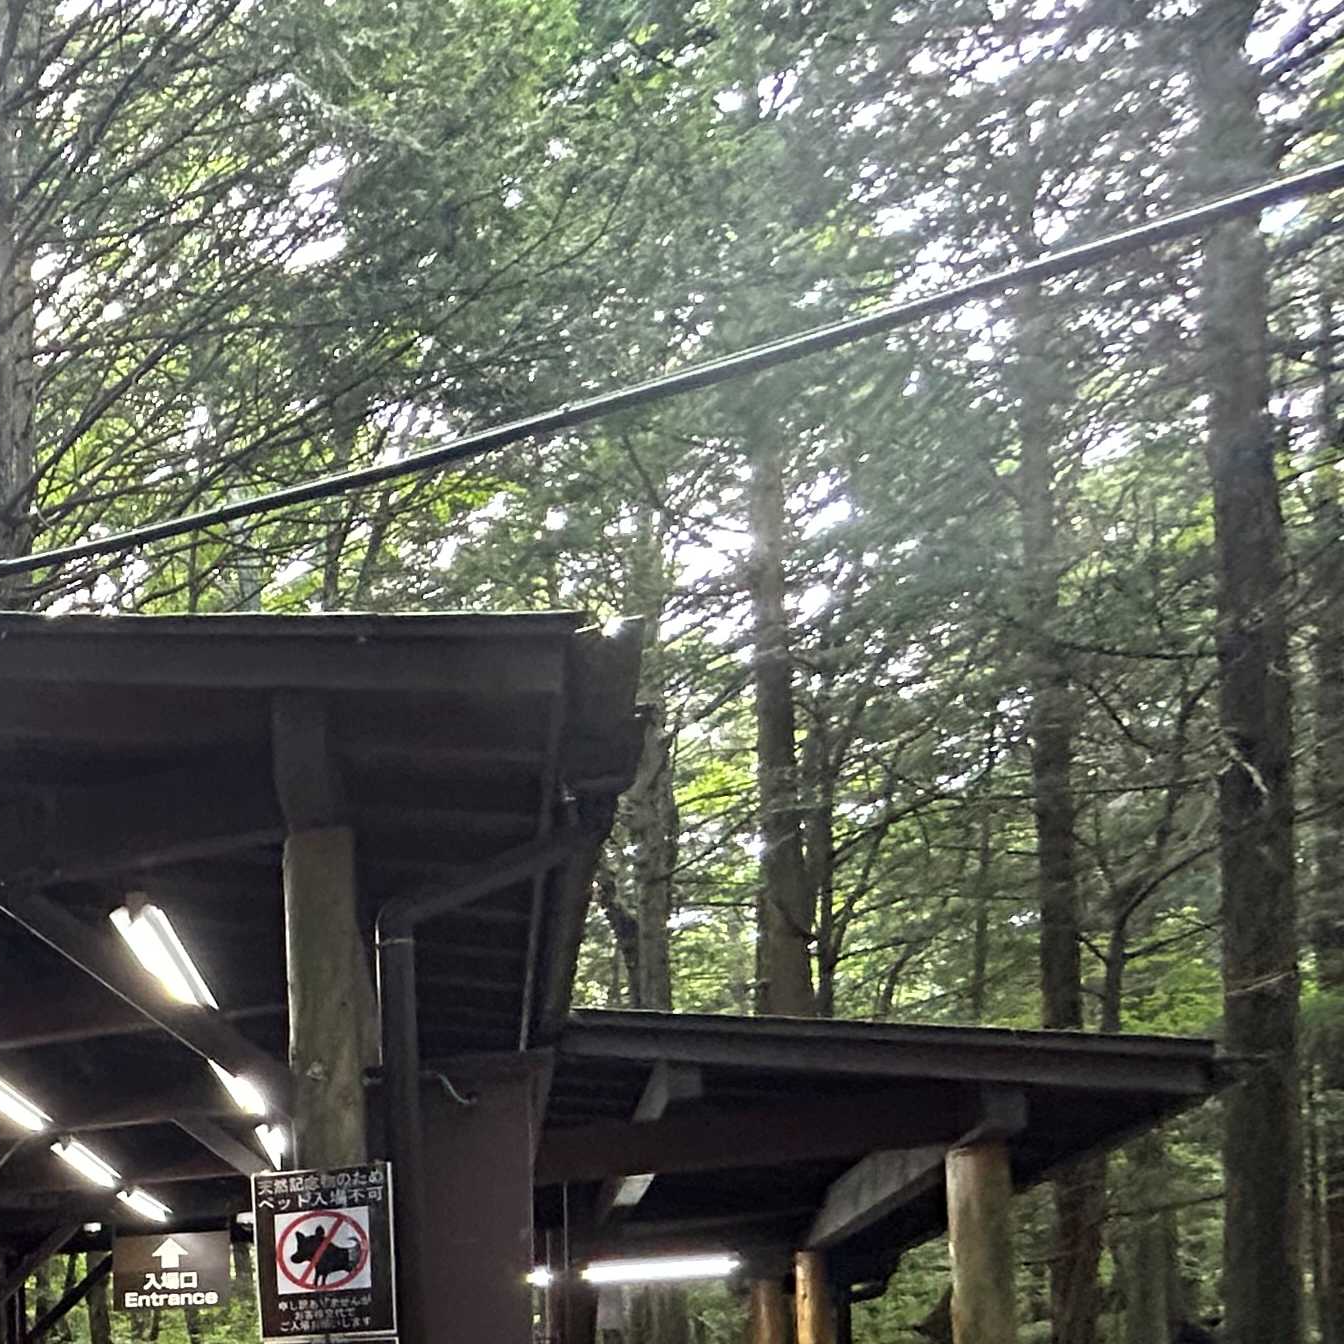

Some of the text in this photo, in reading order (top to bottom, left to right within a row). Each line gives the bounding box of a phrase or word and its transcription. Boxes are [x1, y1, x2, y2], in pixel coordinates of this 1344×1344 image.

[143, 1272, 198, 1290] 入場口
[124, 1291, 219, 1309] Entrance
